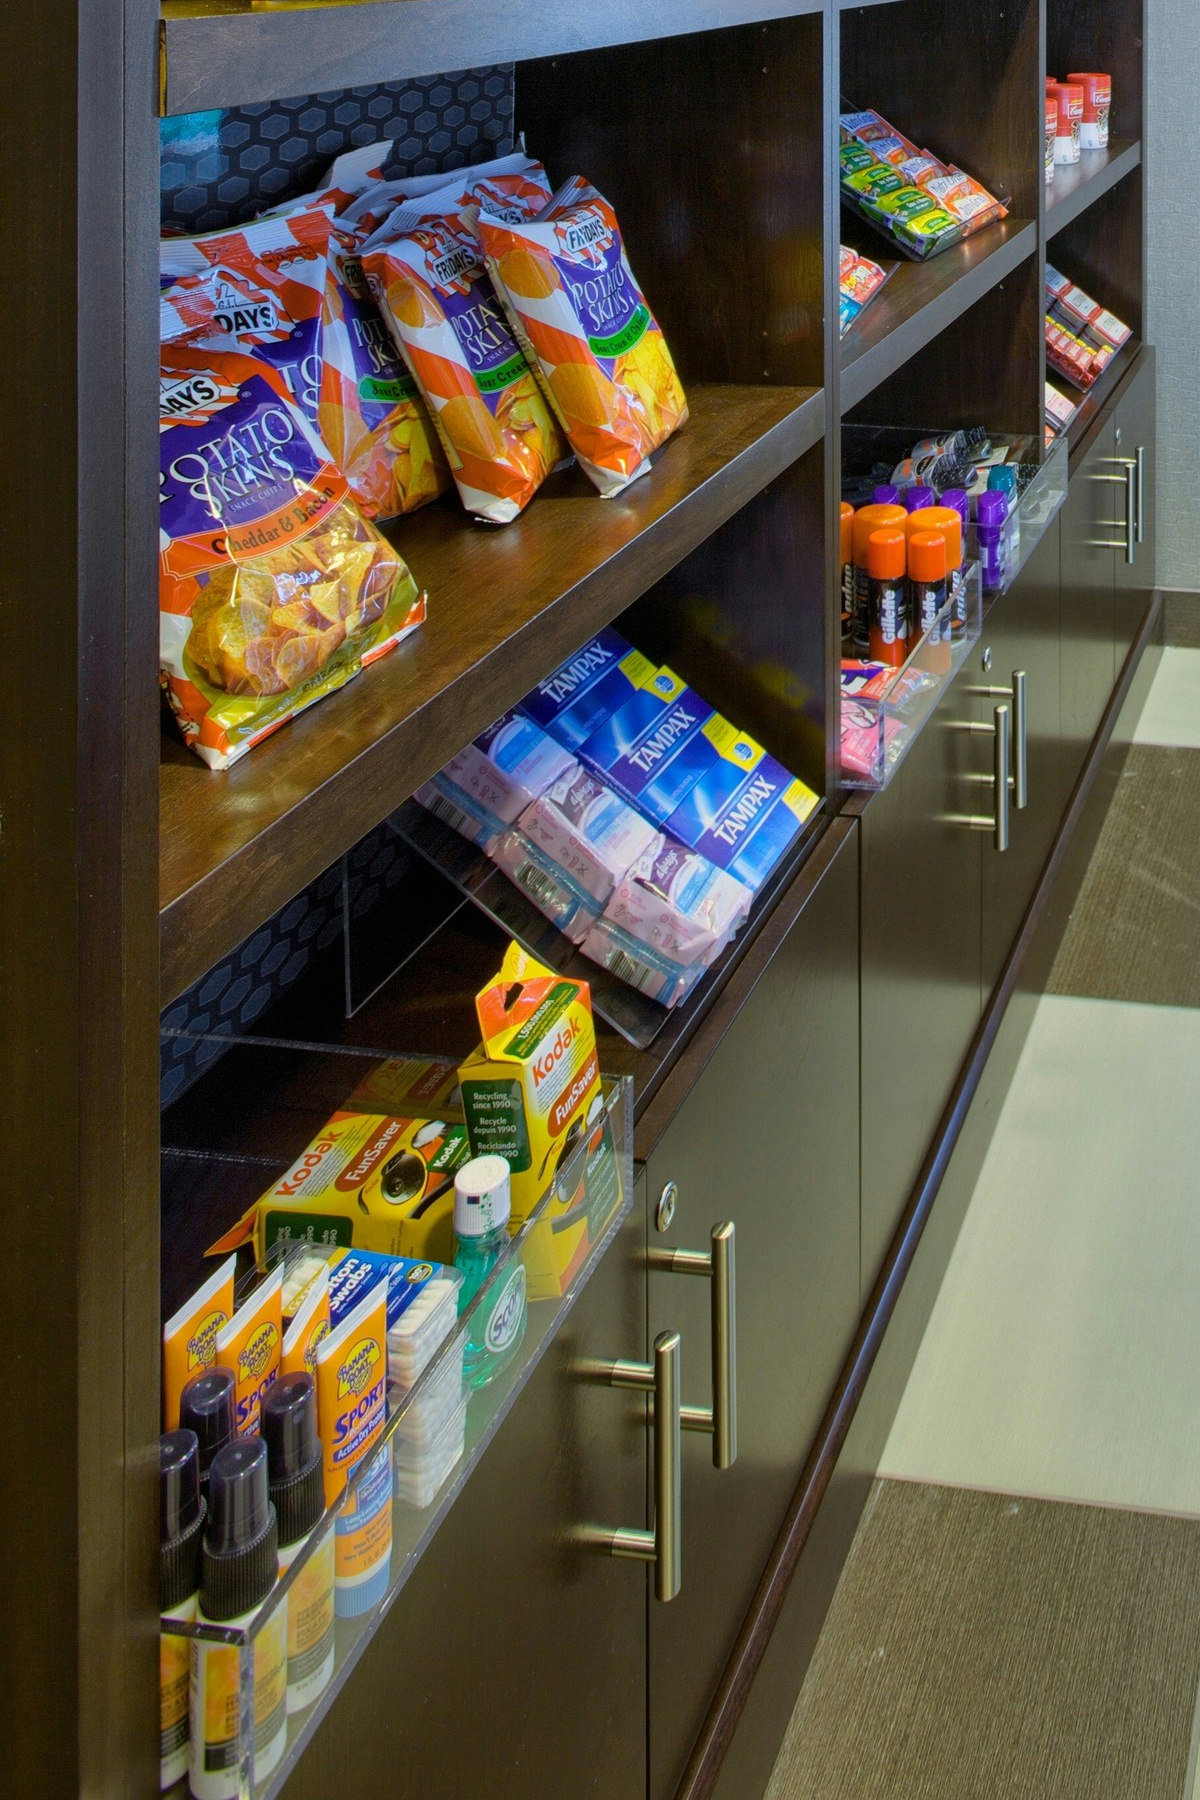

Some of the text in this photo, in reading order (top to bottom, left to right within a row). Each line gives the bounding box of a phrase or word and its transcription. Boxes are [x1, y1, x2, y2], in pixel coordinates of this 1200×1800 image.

[572, 261, 626, 311] POTATO
[588, 287, 630, 332] SKINS
[466, 320, 513, 366] SKIN
[190, 445, 295, 518] SKINS
[230, 483, 285, 513] SNACK CHIPS
[211, 526, 281, 555] Cheddar
[293, 486, 336, 525] Bacon
[881, 589, 896, 645] Gillette
[921, 591, 941, 646] Gillette
[540, 641, 614, 704] TAMPAX
[629, 706, 697, 773] TAMPAX
[569, 778, 596, 807] always
[713, 774, 778, 847] TAMPAX
[655, 849, 679, 880] always
[532, 1015, 581, 1088] Kodak
[472, 1100, 512, 1110] since 1990
[473, 1092, 507, 1103] Recycling
[554, 1058, 597, 1126] FunSaver
[473, 1124, 517, 1135] depuis 1990
[479, 1116, 507, 1126] Recycle
[275, 1130, 344, 1197] Kodak
[344, 1121, 402, 1182] FunSaver
[433, 1136, 463, 1168] Kodak
[477, 1141, 517, 1150] Reciclando
[330, 1262, 373, 1311] Swabs
[187, 1314, 224, 1354] BANANA
[239, 1324, 274, 1365] BANANA
[338, 1339, 376, 1380] BANANA
[236, 1365, 279, 1428] SPOR
[333, 1378, 386, 1444] SPORT
[337, 1438, 358, 1460] Active
[357, 1427, 370, 1445] Dry
